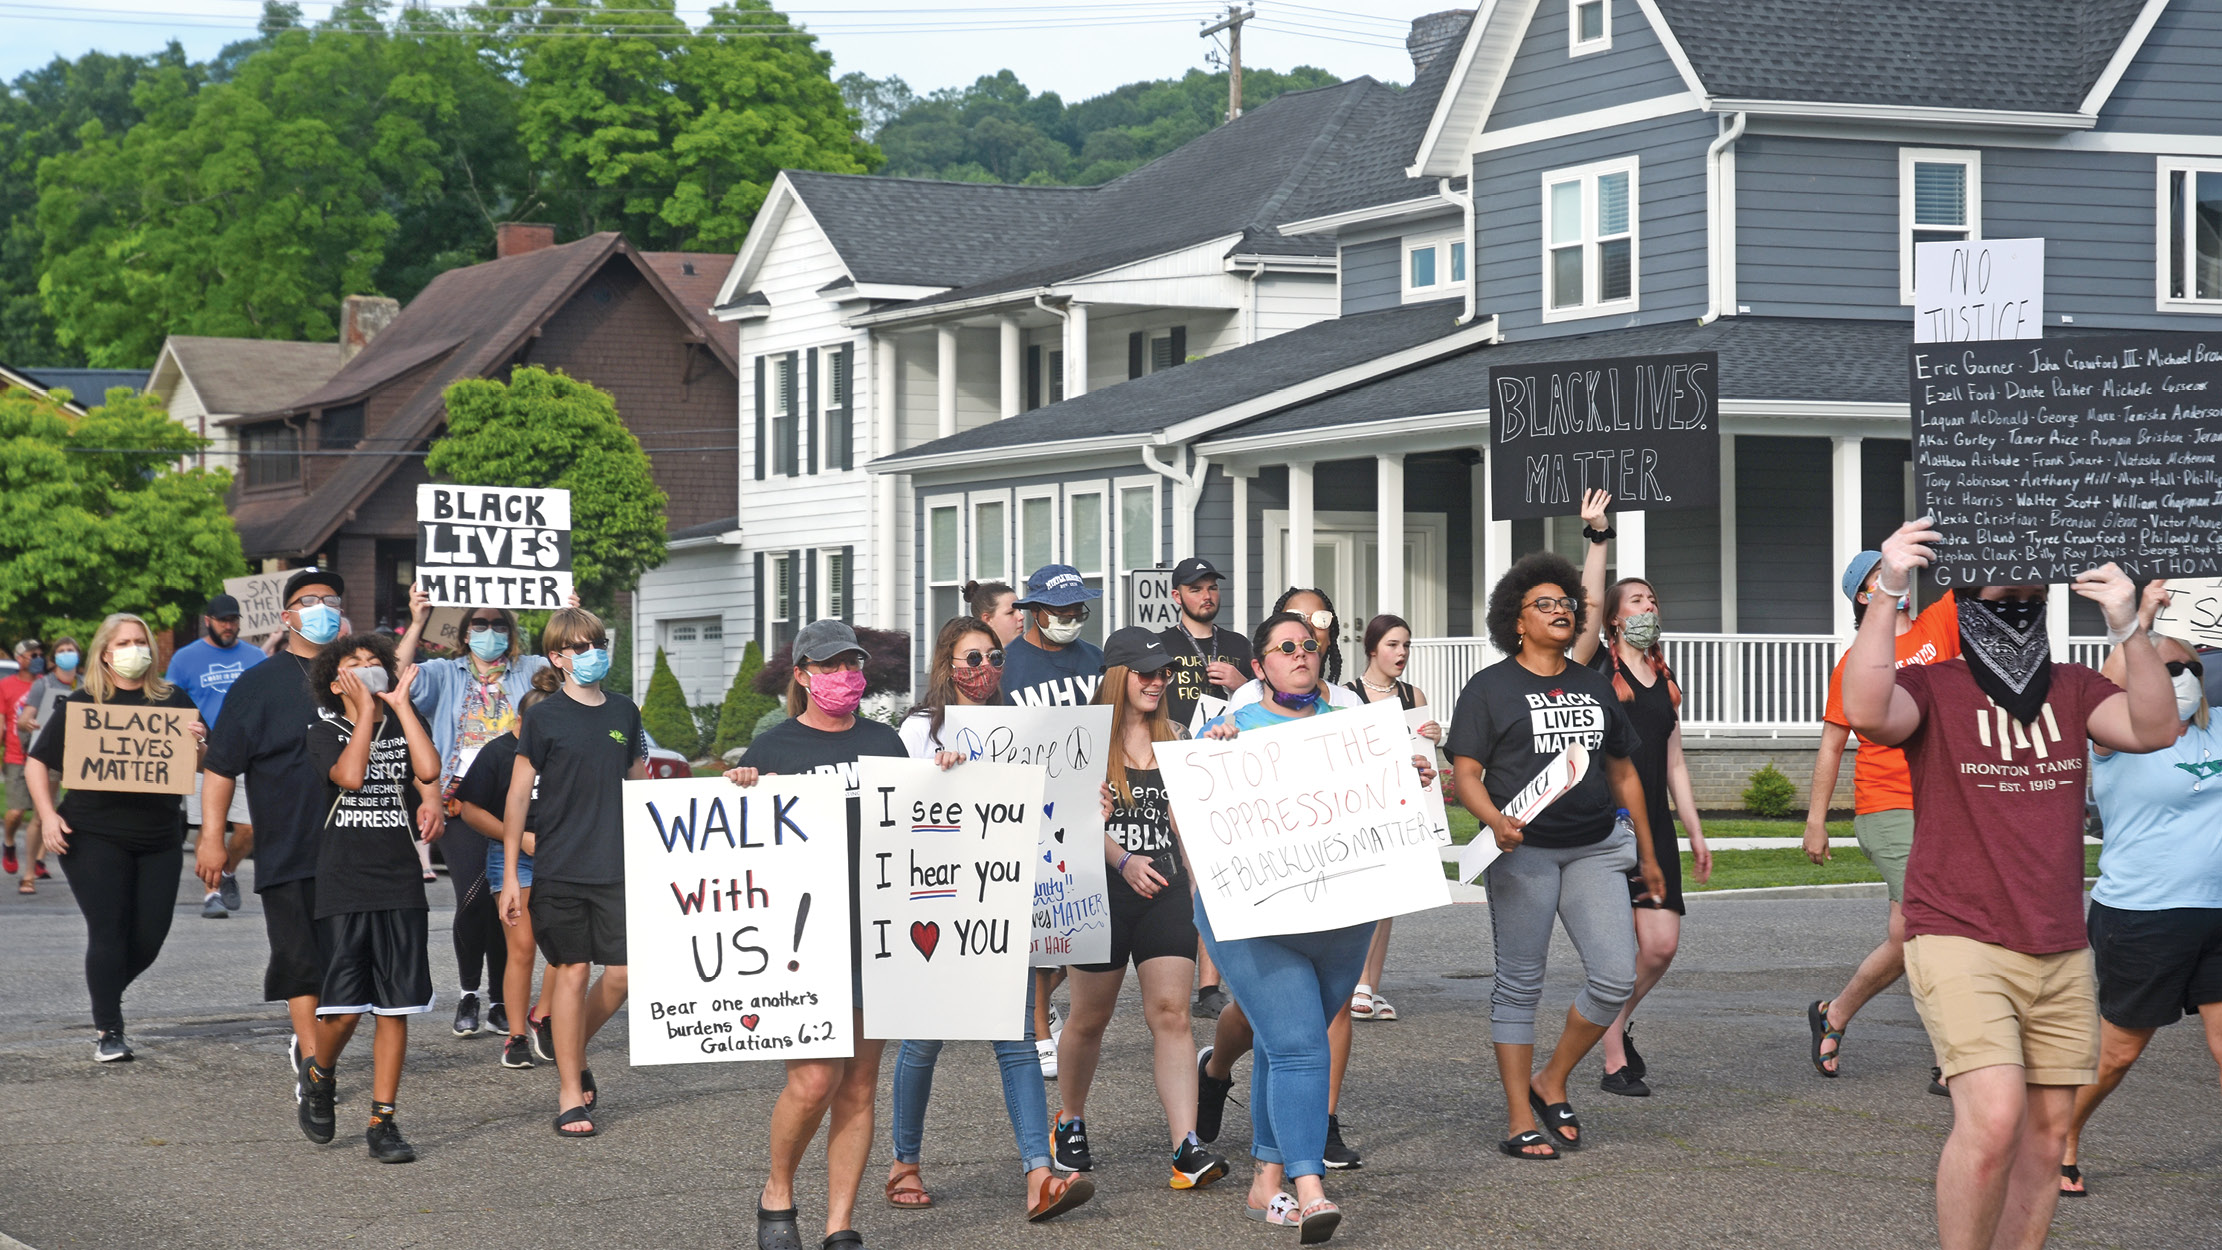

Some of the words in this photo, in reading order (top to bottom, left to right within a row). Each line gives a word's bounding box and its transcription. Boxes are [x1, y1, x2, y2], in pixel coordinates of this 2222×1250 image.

[1950, 248, 1991, 295] NO
[1915, 354, 1959, 379] Eric
[1962, 350, 2015, 375] Garner
[2028, 347, 2061, 374] John
[1925, 384, 1963, 406] Ezell
[1967, 383, 1996, 401] Ford
[2004, 380, 2045, 400] Dante
[2037, 406, 2079, 428] George
[2170, 403, 2222, 421] Anderso
[2049, 429, 2079, 446] Rice
[2068, 451, 2104, 467] Smart
[1922, 472, 1951, 492] Tony
[1956, 472, 2010, 488] Robinson
[2020, 471, 2080, 492] Anthony
[2084, 471, 2111, 485] Hill
[2117, 471, 2146, 488] Mya
[2150, 469, 2176, 487] Hall
[434, 489, 546, 527] BLACK
[1926, 492, 1956, 505] Eric
[1962, 492, 2004, 507] Harris
[2016, 493, 2058, 507] Walter
[2063, 493, 2102, 509] Scott
[2112, 494, 2158, 509] William
[1974, 511, 2038, 527] Christian
[2149, 513, 2186, 528] Victor
[2186, 515, 2222, 530] Manue
[424, 524, 560, 569] LIVES
[1927, 530, 1970, 546] ndra
[1976, 529, 2016, 545] Bland
[2063, 530, 2126, 545] Crawford
[2062, 546, 2088, 561] Ray
[2093, 544, 2127, 559] Davis
[2137, 543, 2180, 557] George
[247, 579, 281, 598] SAY
[420, 574, 562, 606] MATTER
[1140, 579, 1168, 599] ON
[242, 596, 282, 613] THEI
[1139, 604, 1182, 622] WAY
[248, 612, 283, 629] NAM
[1178, 671, 1191, 684] IS
[1525, 693, 1600, 709] BLACK
[82, 708, 182, 736] BLACK
[1544, 709, 1594, 729] LIVES
[99, 737, 174, 759] LIVES
[1534, 731, 1604, 753] MATTER
[394, 749, 406, 759] OF
[1185, 741, 1280, 801] STOP
[1303, 725, 1392, 771] THE
[81, 757, 169, 784] MATTER
[1960, 762, 2030, 777] IRONTON
[2035, 757, 2083, 775] TANKS
[1998, 781, 2026, 793] EST.
[2029, 778, 2057, 791] 1919
[341, 796, 357, 806] THE
[357, 796, 379, 807] SIDE
[380, 797, 390, 806] OF
[1210, 761, 1407, 845] OPPRESSION!
[335, 809, 409, 828] OPPRESSO
[646, 794, 809, 853] WALK
[877, 786, 896, 827] I
[911, 799, 962, 825] see
[974, 801, 1025, 840] you
[1106, 823, 1172, 851] #BLM
[875, 852, 893, 891] I
[910, 848, 962, 888] hear
[974, 860, 1021, 903] you
[669, 869, 770, 916] With
[872, 919, 893, 960] I
[953, 918, 1010, 957] YOU
[1045, 935, 1073, 955] HATE
[650, 999, 699, 1021] Bear
[711, 996, 744, 1013] one
[750, 990, 819, 1010] another's
[666, 1020, 733, 1039] burdens
[700, 1033, 794, 1055] Galatians
[797, 1021, 837, 1045] 6:2
